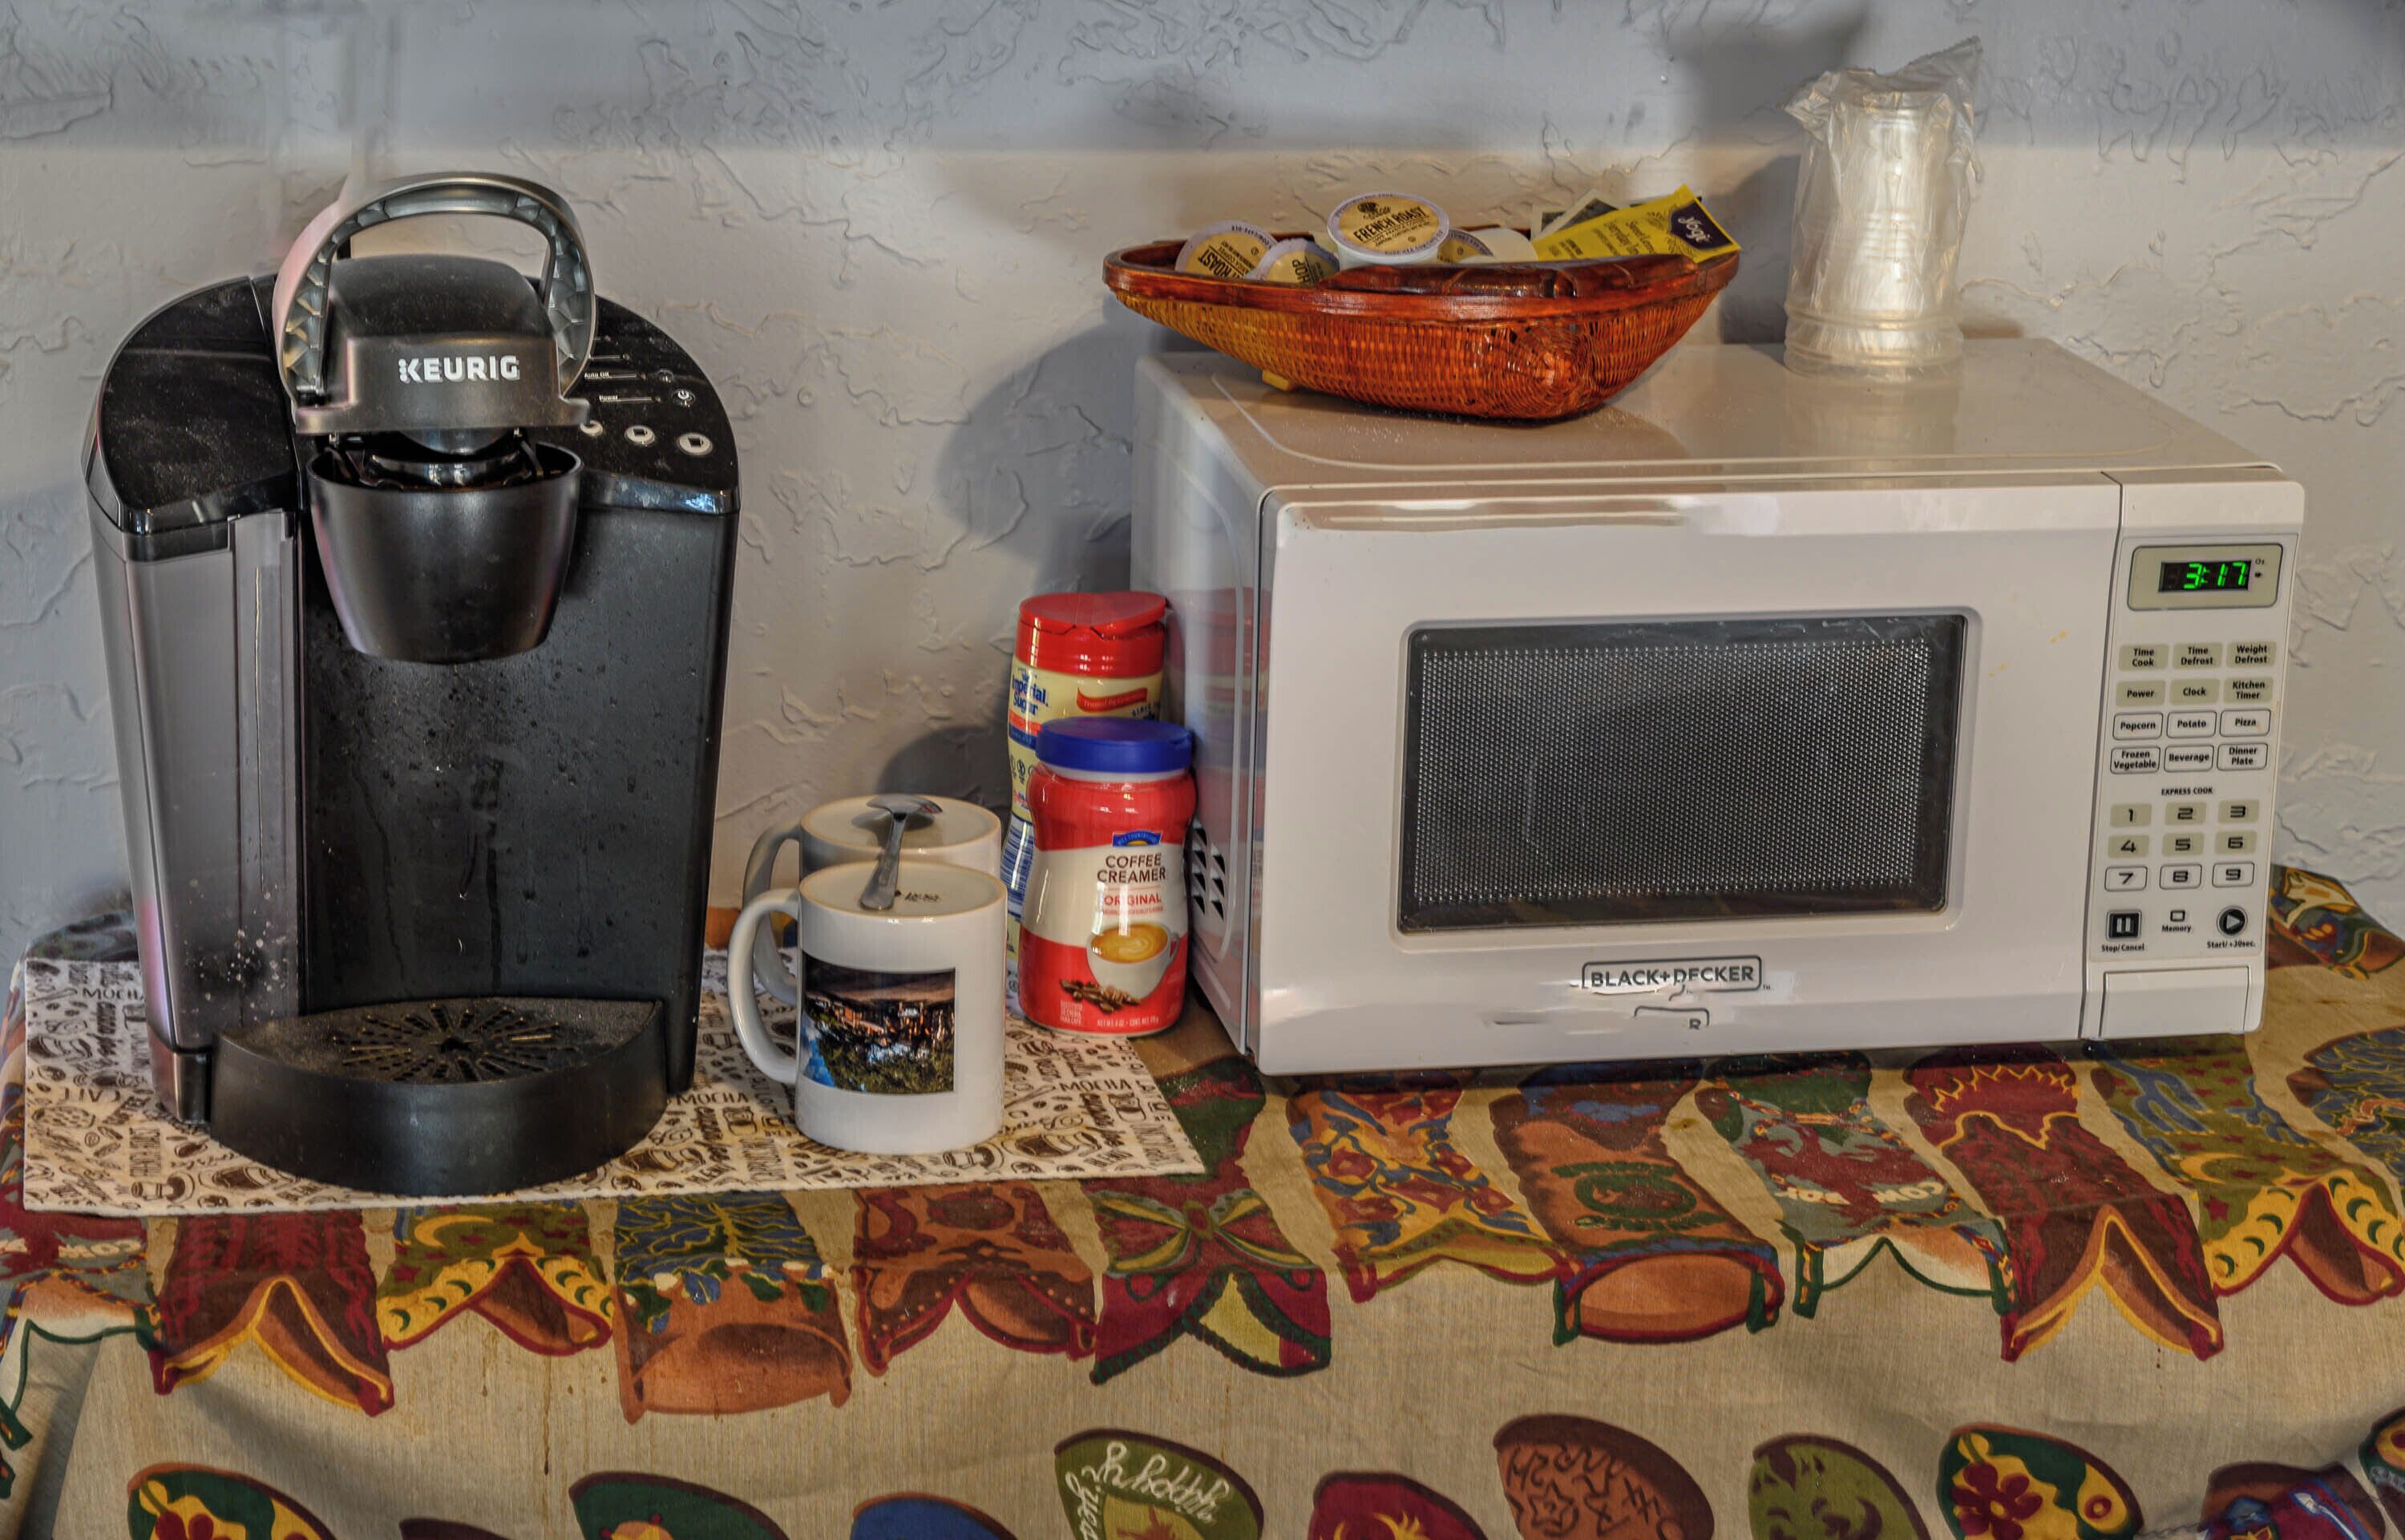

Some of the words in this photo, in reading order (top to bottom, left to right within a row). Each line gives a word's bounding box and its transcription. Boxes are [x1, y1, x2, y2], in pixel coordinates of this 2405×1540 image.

[1353, 217, 1397, 243] FRENCH
[1391, 206, 1427, 224] ROAST
[398, 355, 519, 383] KEURIG
[2183, 561, 2247, 590] 3:17
[2133, 647, 2154, 657] Time
[2188, 646, 2209, 655] Time
[2237, 645, 2267, 655] Weight
[2132, 657, 2154, 667] Cook
[2181, 656, 2213, 665] Defrost
[2234, 655, 2267, 665] Defrost
[2232, 680, 2266, 690] Kitchen
[2126, 689, 2155, 698] Power
[2183, 686, 2207, 696] Clock
[2236, 691, 2261, 700] Timer
[2120, 721, 2156, 731] Popcorn
[2177, 719, 2207, 728] Potato
[2235, 717, 2257, 727] Pizza
[2121, 750, 2151, 758] Frozen
[2229, 746, 2257, 755] Dinner
[2169, 753, 2210, 762] Beverage
[2231, 757, 2253, 766] Plate
[2113, 760, 2156, 770] Vegetable
[2161, 788, 2191, 796] EXPRESS
[2193, 787, 2213, 795] COOK
[2128, 808, 2134, 822] 1
[2177, 807, 2194, 820] 2
[2230, 805, 2247, 818] 3
[2120, 840, 2136, 853] 4
[2175, 838, 2191, 851] 5
[2227, 837, 2243, 849] 6
[1105, 853, 1162, 868] COFFEE
[1097, 867, 1166, 883] CREAMER
[2118, 872, 2134, 885] 7
[2173, 870, 2189, 883] 8
[2225, 869, 2241, 881] 9
[1104, 891, 1162, 906] ORGINAL
[2162, 925, 2192, 934] Memory
[83, 987, 144, 1000] MOCH
[1059, 1079, 1133, 1092] MOCHA
[675, 1092, 749, 1106] MOCHA
